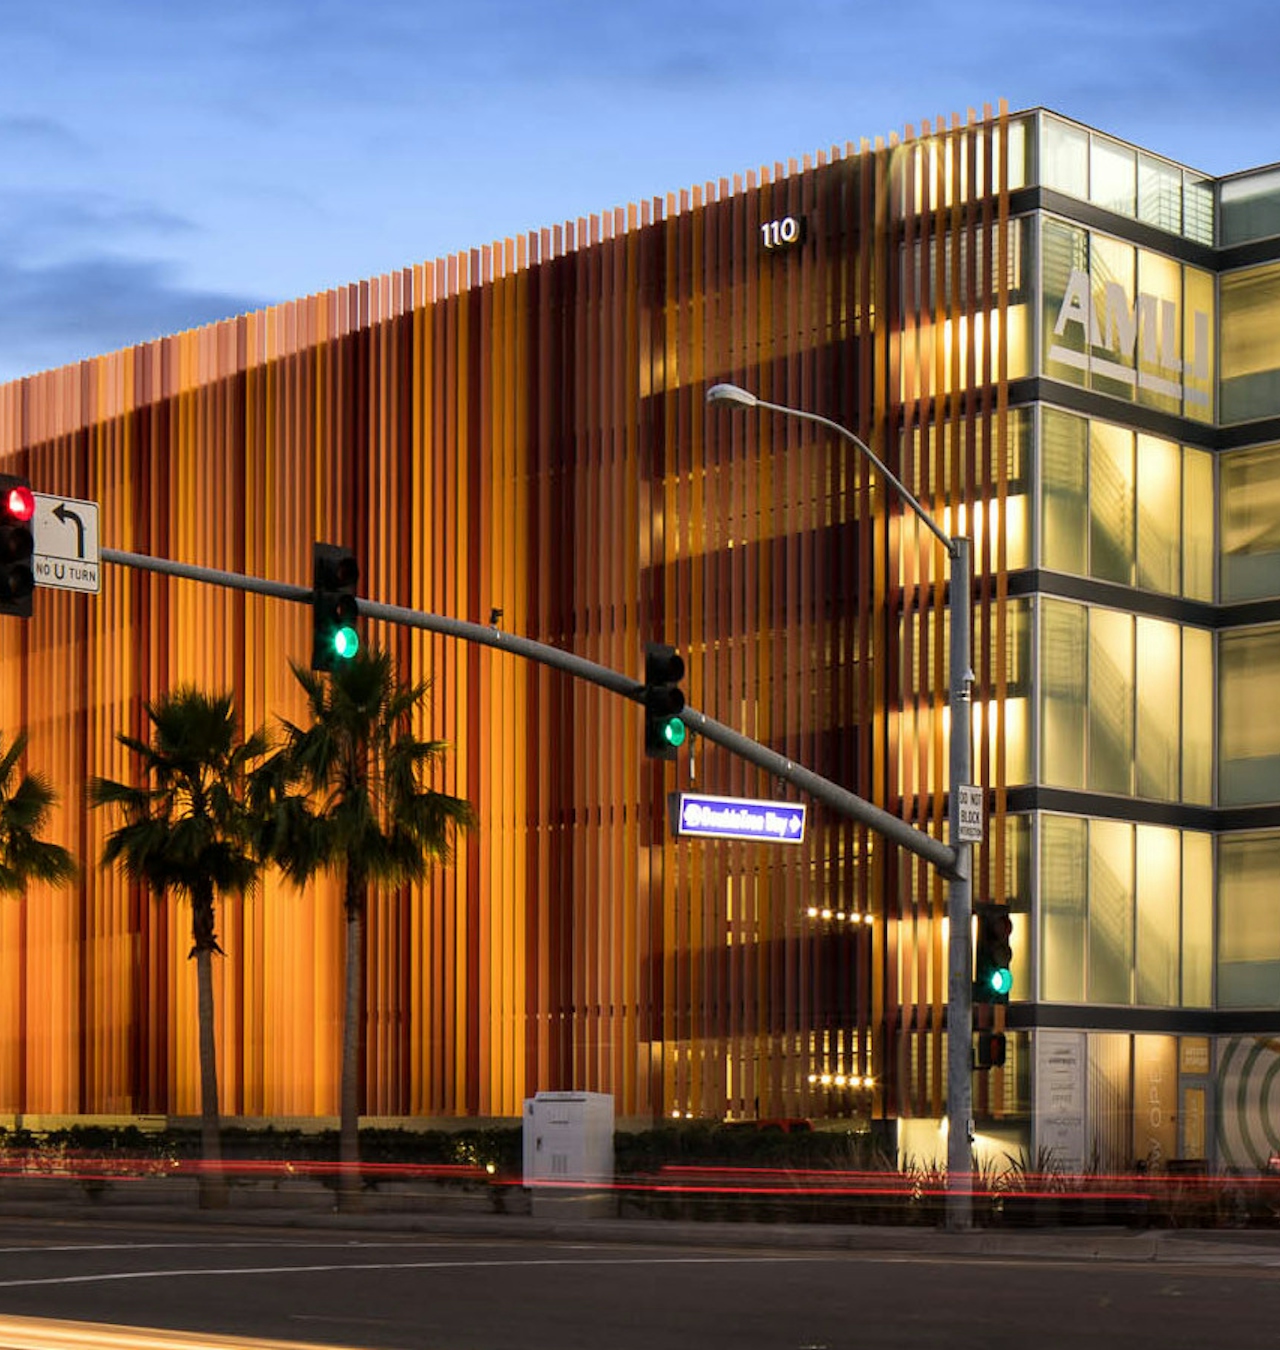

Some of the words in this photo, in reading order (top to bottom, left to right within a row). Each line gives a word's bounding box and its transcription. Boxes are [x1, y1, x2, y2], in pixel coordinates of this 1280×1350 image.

[761, 216, 799, 248] 110
[1053, 268, 1209, 381] AMLI
[36, 562, 50, 575] NO
[55, 563, 65, 579] U
[69, 568, 96, 581] TURN
[959, 791, 968, 804] DO
[970, 792, 982, 806] NOT
[961, 809, 980, 823] BLOCK
